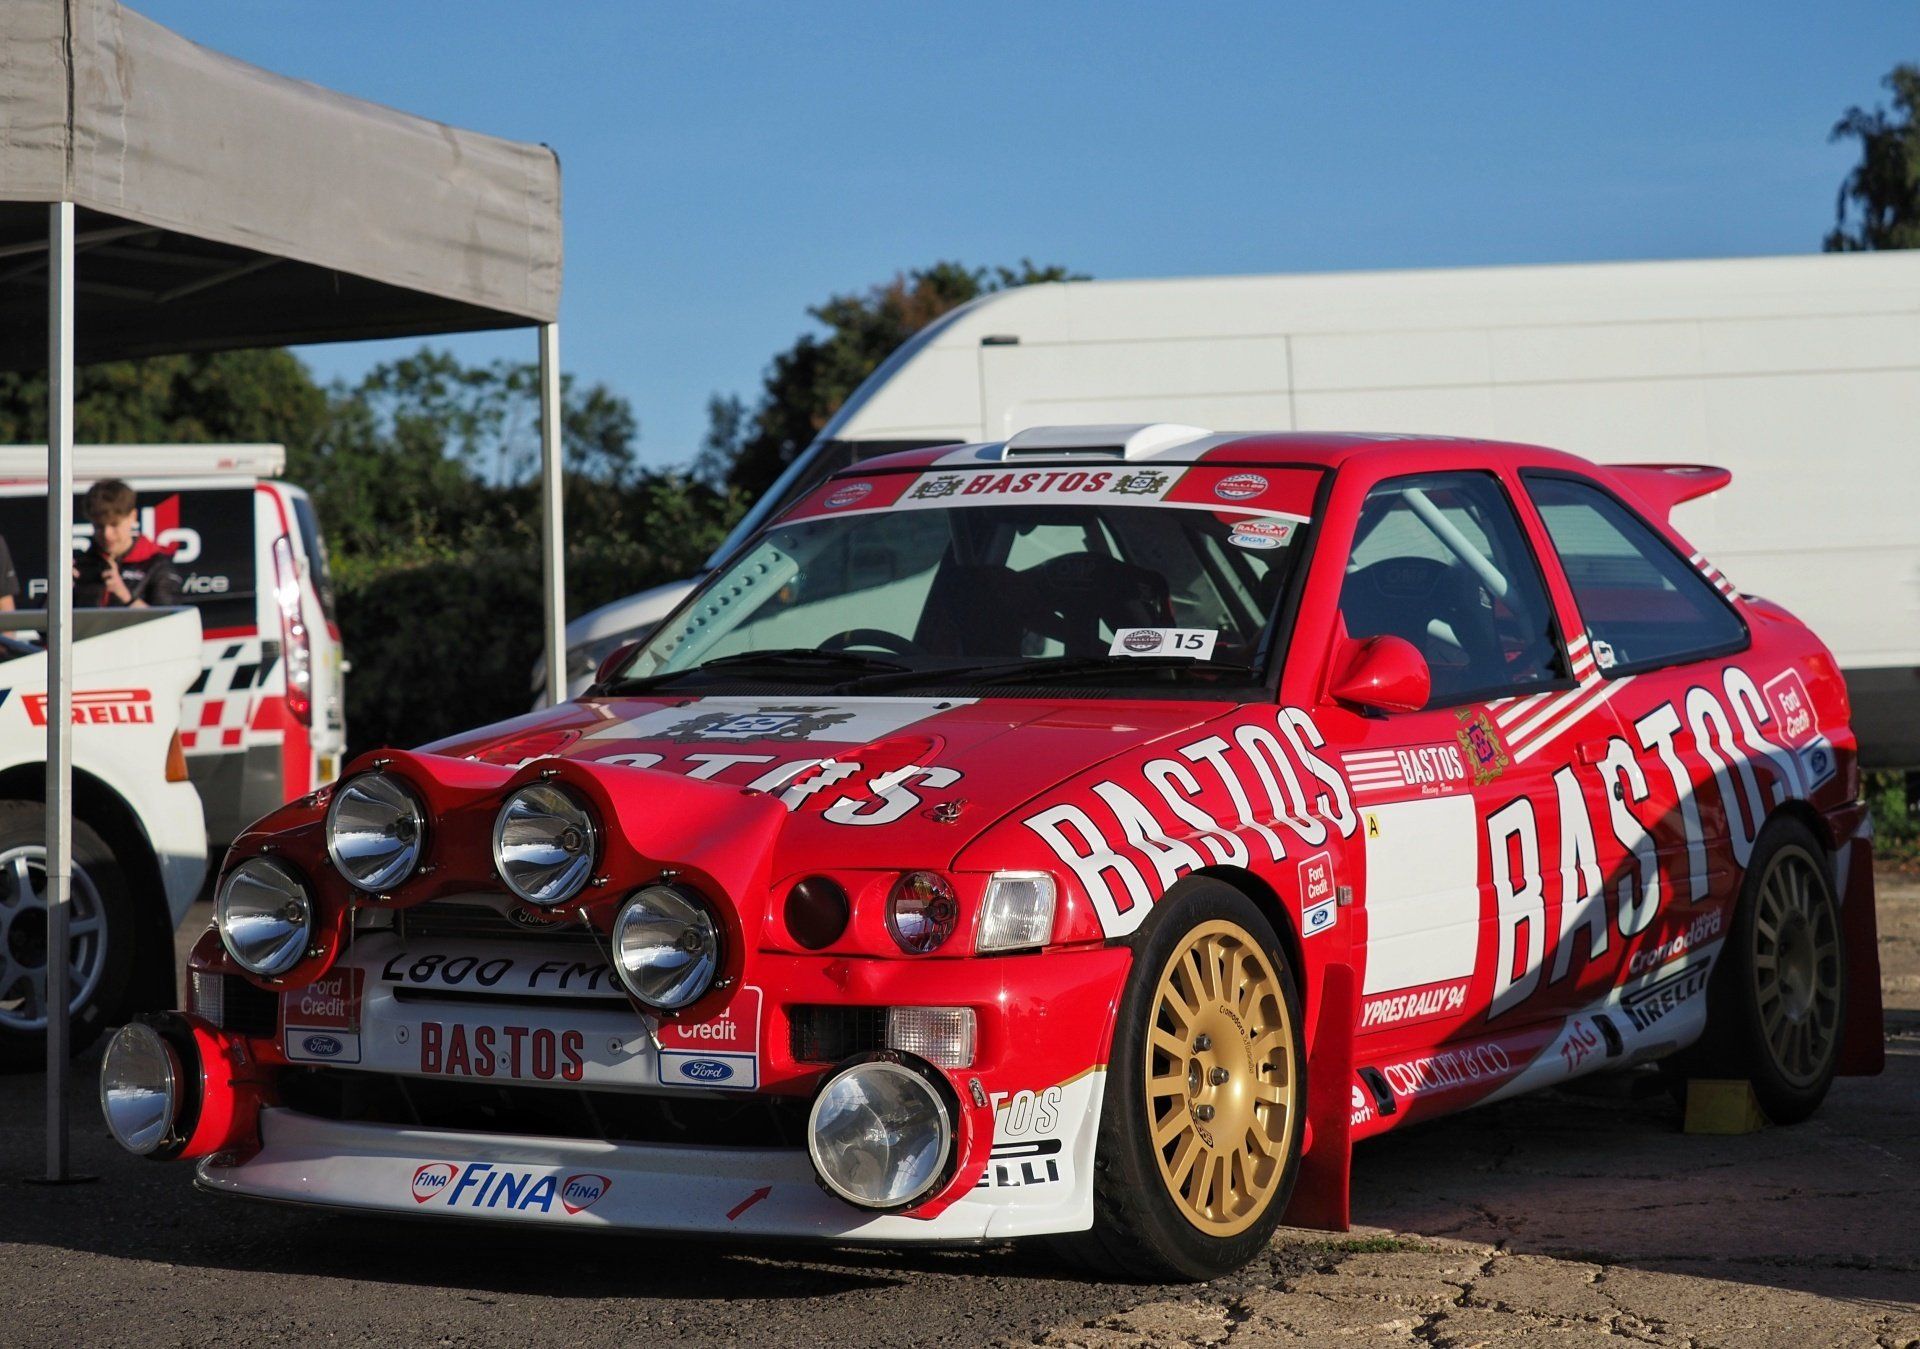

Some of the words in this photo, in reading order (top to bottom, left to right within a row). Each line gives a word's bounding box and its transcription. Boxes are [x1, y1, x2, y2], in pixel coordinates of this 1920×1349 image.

[961, 472, 1112, 495] BASTOS
[1175, 633, 1205, 650] 15
[21, 689, 154, 726] PRELLI
[1397, 745, 1464, 785] BASTOS
[1021, 706, 1358, 939] BASTOS
[1370, 816, 1378, 835] A
[1486, 666, 1802, 1024] BASTOS
[1308, 864, 1324, 882] Ford
[1308, 879, 1328, 899] Credit
[1628, 915, 1721, 974] Cromodora
[308, 978, 342, 996] Ford
[382, 953, 514, 987] L800
[301, 996, 345, 1016] Credit
[1361, 995, 1407, 1027] YPRES
[1403, 987, 1450, 1019] RALLY
[1620, 955, 1712, 1032] PIRELLI
[311, 1038, 335, 1053] Ford
[677, 1020, 737, 1041] Credit
[421, 1022, 584, 1082] BASTOS
[690, 1062, 722, 1078] Ford
[1384, 1053, 1465, 1097] CRICKET
[1460, 1050, 1480, 1078] &
[1476, 1043, 1510, 1075] CO
[415, 1172, 447, 1187] FINA
[447, 1163, 557, 1213] FINA
[565, 1182, 600, 1200] FINA
